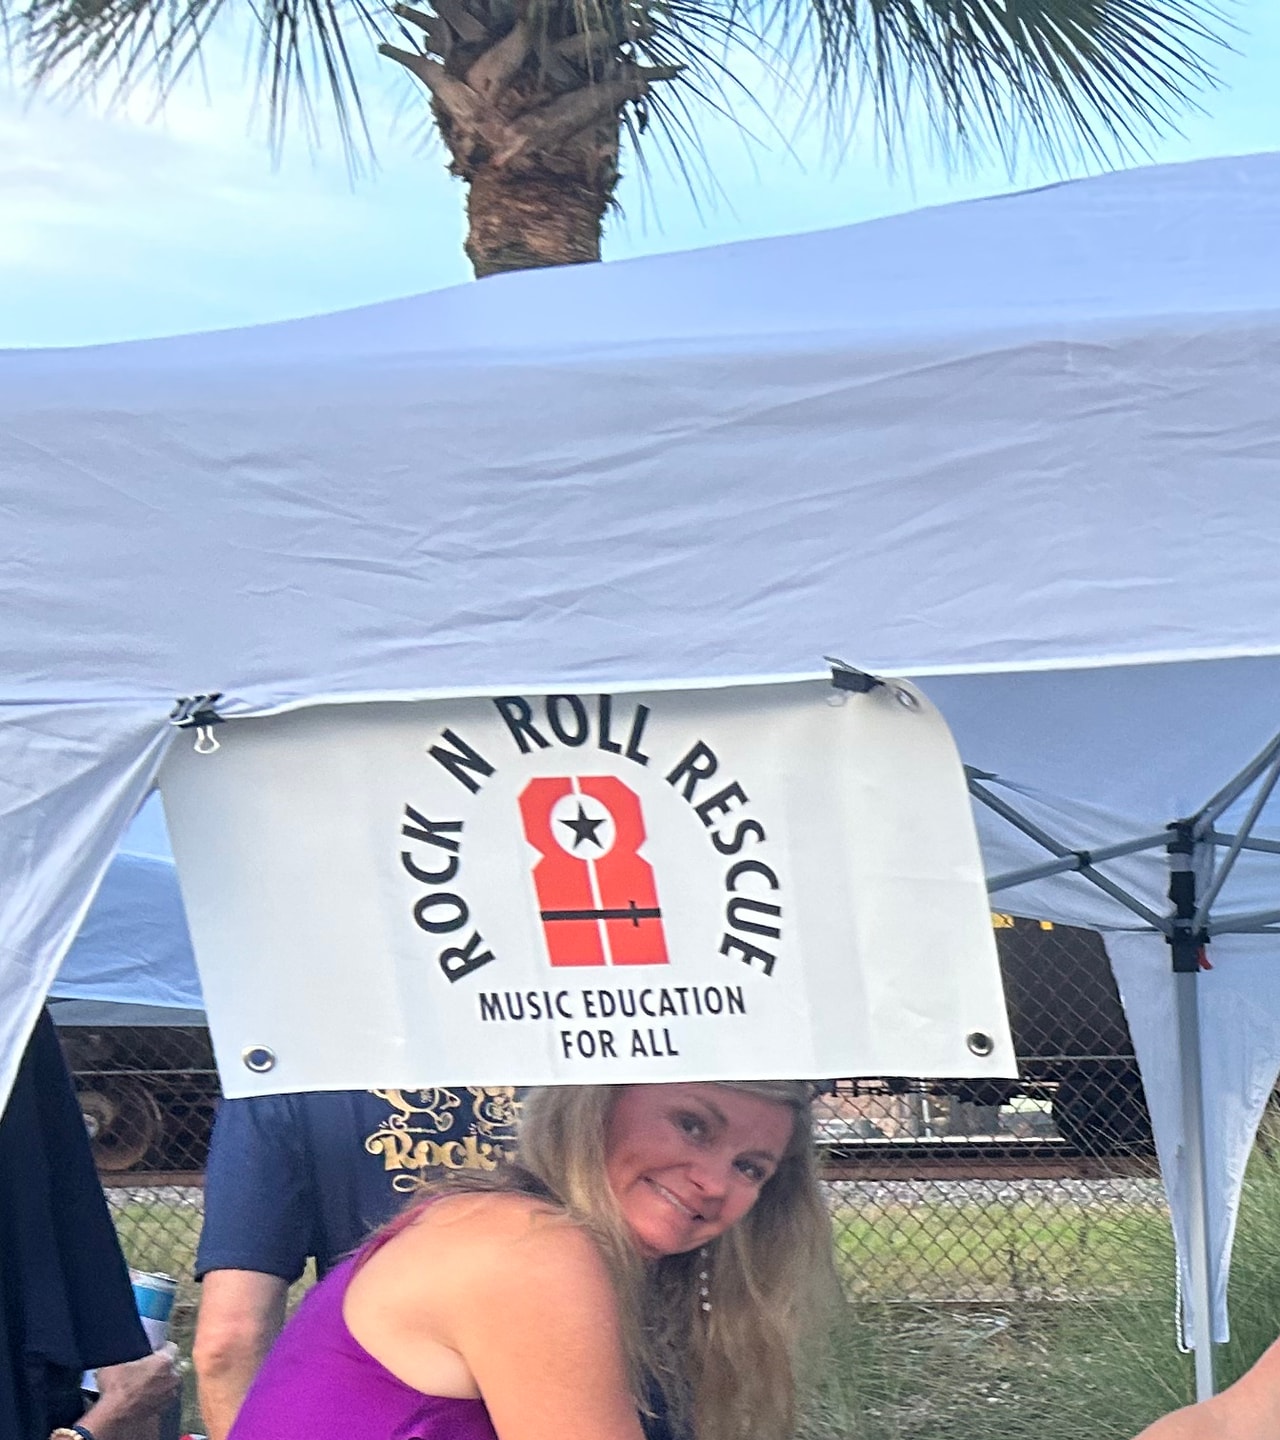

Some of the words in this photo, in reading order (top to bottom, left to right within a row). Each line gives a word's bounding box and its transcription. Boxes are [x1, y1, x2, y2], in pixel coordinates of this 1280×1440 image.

[427, 727, 497, 794] N
[493, 693, 653, 768] ROLL
[401, 802, 496, 983] ROCK
[665, 740, 786, 976] RESCUE
[479, 990, 575, 1023] MUSIC
[582, 985, 746, 1020] EDUCATION
[561, 1029, 618, 1060] FOR
[629, 1028, 680, 1059] ALL
